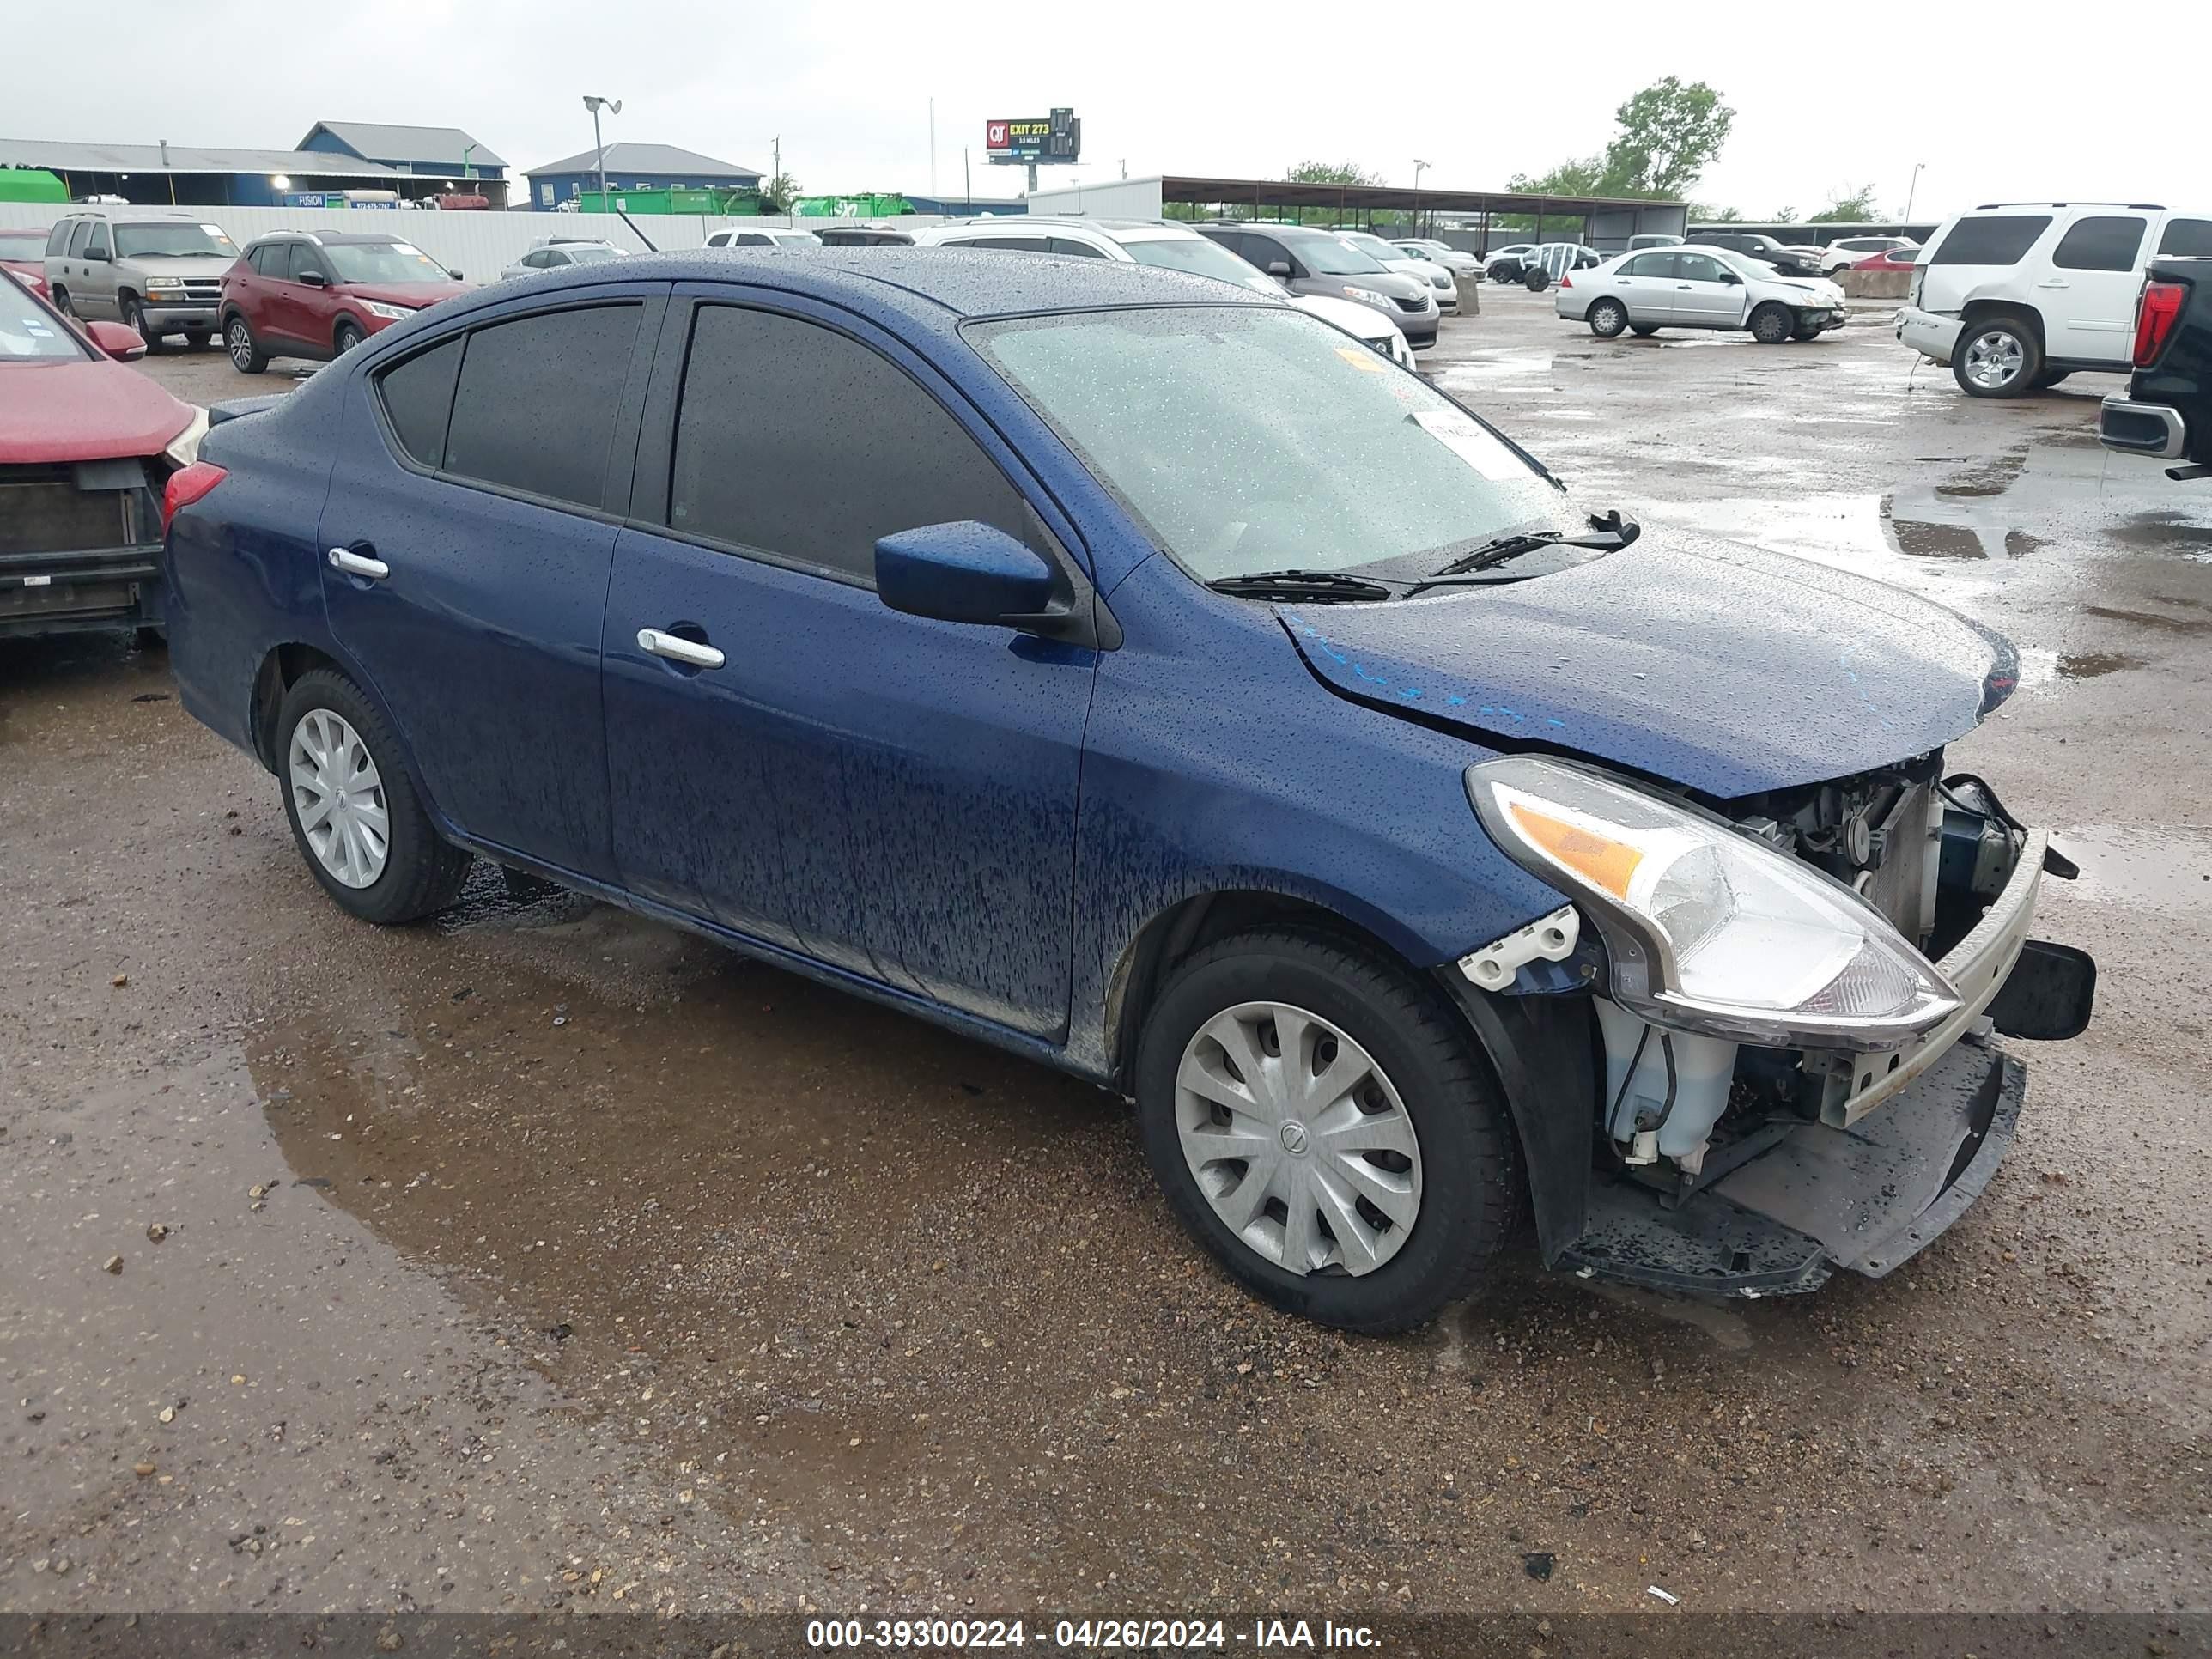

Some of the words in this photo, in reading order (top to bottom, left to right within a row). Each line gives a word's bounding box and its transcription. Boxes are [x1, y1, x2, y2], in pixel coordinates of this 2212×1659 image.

[989, 125, 1006, 143] QT
[1010, 125, 1030, 135] EXIT
[1032, 124, 1049, 134] 273
[299, 196, 323, 206] FUSION
